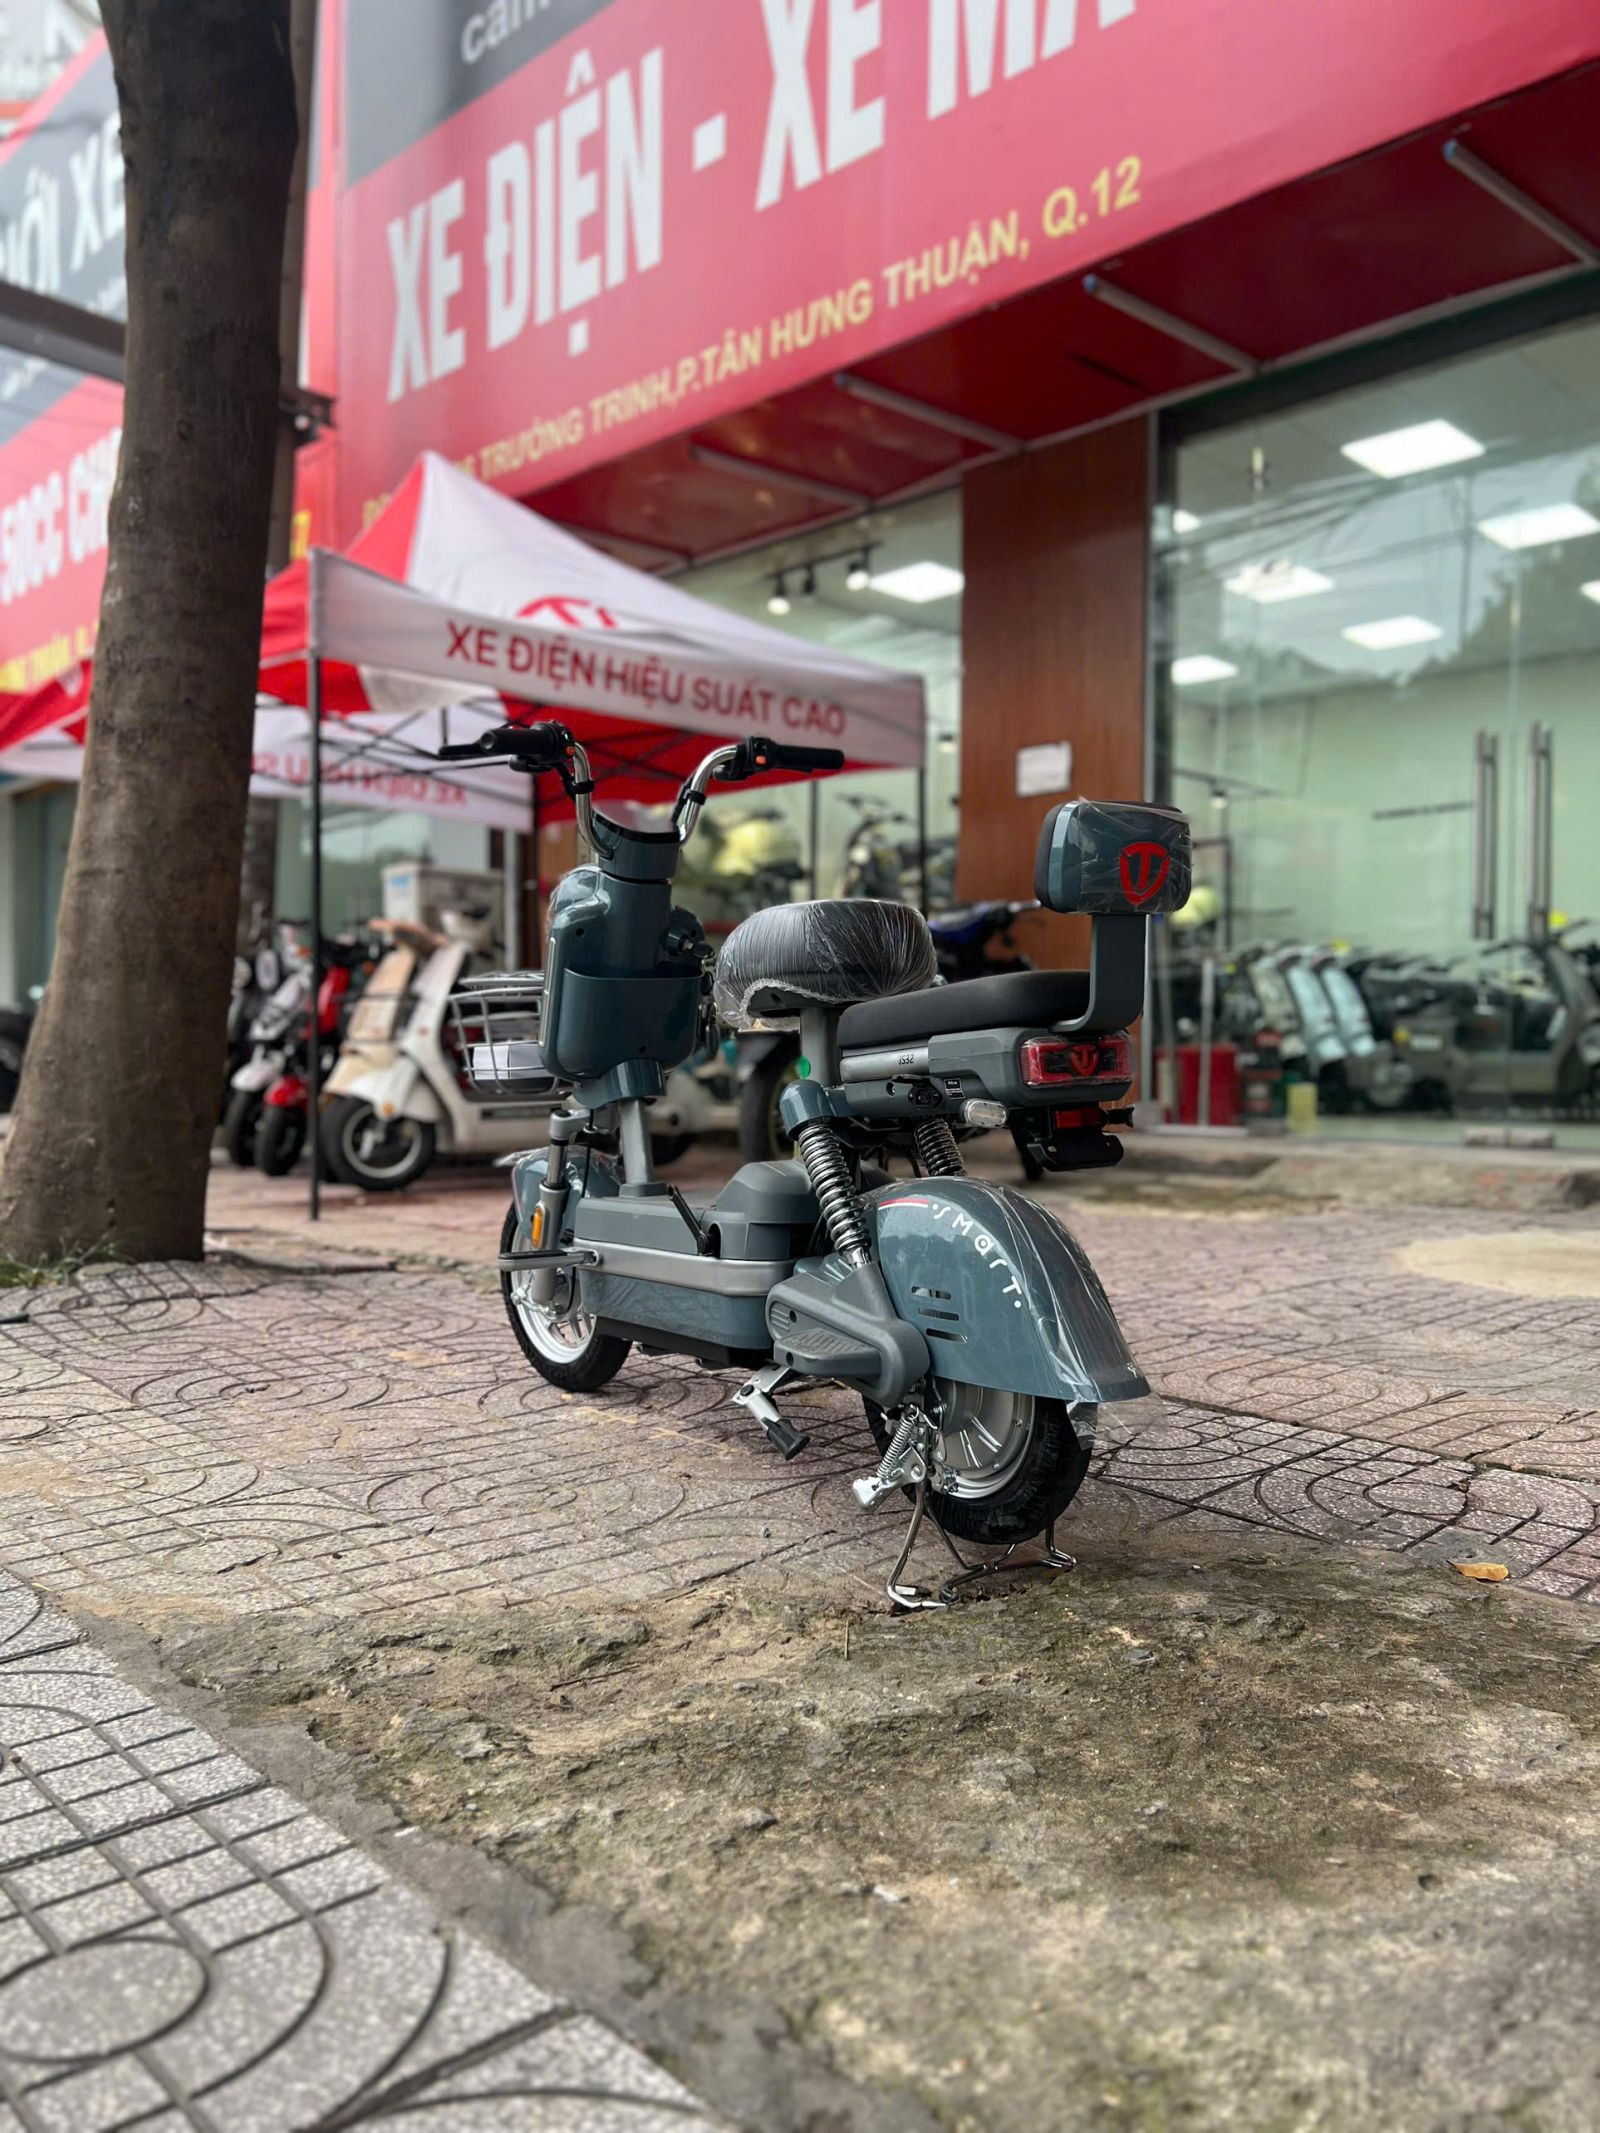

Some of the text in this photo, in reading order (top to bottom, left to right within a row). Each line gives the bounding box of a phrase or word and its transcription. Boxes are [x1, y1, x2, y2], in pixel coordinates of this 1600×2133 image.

[387, 178, 466, 402] XE
[484, 47, 663, 357] ĐIỆN
[755, 0, 886, 211] XE
[769, 278, 873, 359] HƯNG
[882, 209, 1029, 309] THUẬN,
[1043, 155, 1141, 238] Q.12
[446, 620, 846, 736] XE ĐIỆN HIỆU SUẤT CAO
